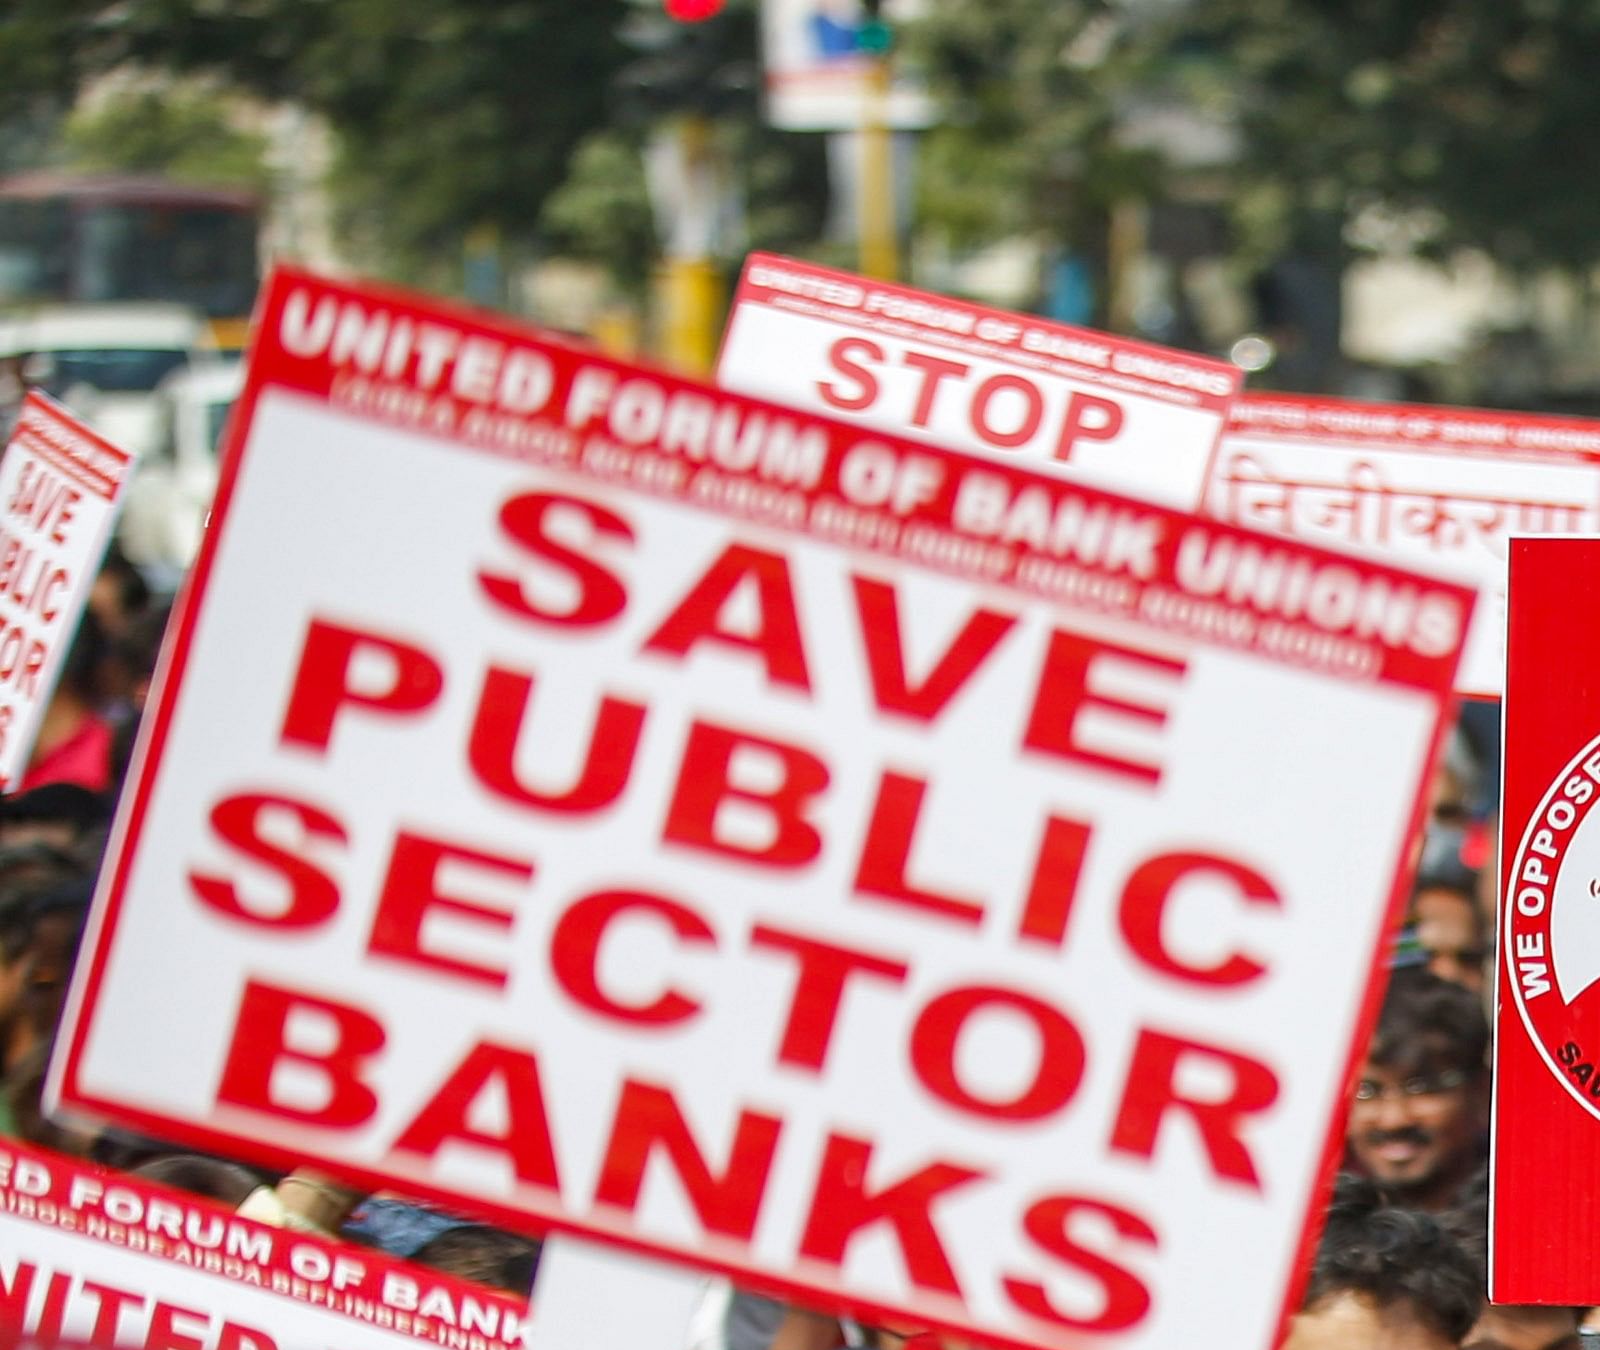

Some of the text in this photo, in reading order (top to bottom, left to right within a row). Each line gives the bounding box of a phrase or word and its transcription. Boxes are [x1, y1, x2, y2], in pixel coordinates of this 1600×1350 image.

[748, 264, 1233, 395] UNITED FORUM OF BANK UNIONS
[815, 336, 1124, 461] STOP
[9, 460, 81, 546] SAVE
[279, 289, 1462, 659] UNITED FORUM OF BANK UNIONS
[474, 488, 1193, 789] SAVE
[276, 616, 1286, 995] PUBLIC
[187, 791, 1284, 1194] SECTOR
[1517, 931, 1553, 1000] WE
[69, 1174, 273, 1267] FORUM
[290, 1242, 366, 1291] OF
[382, 1273, 533, 1347] BANK
[214, 977, 1163, 1334] BANKS
